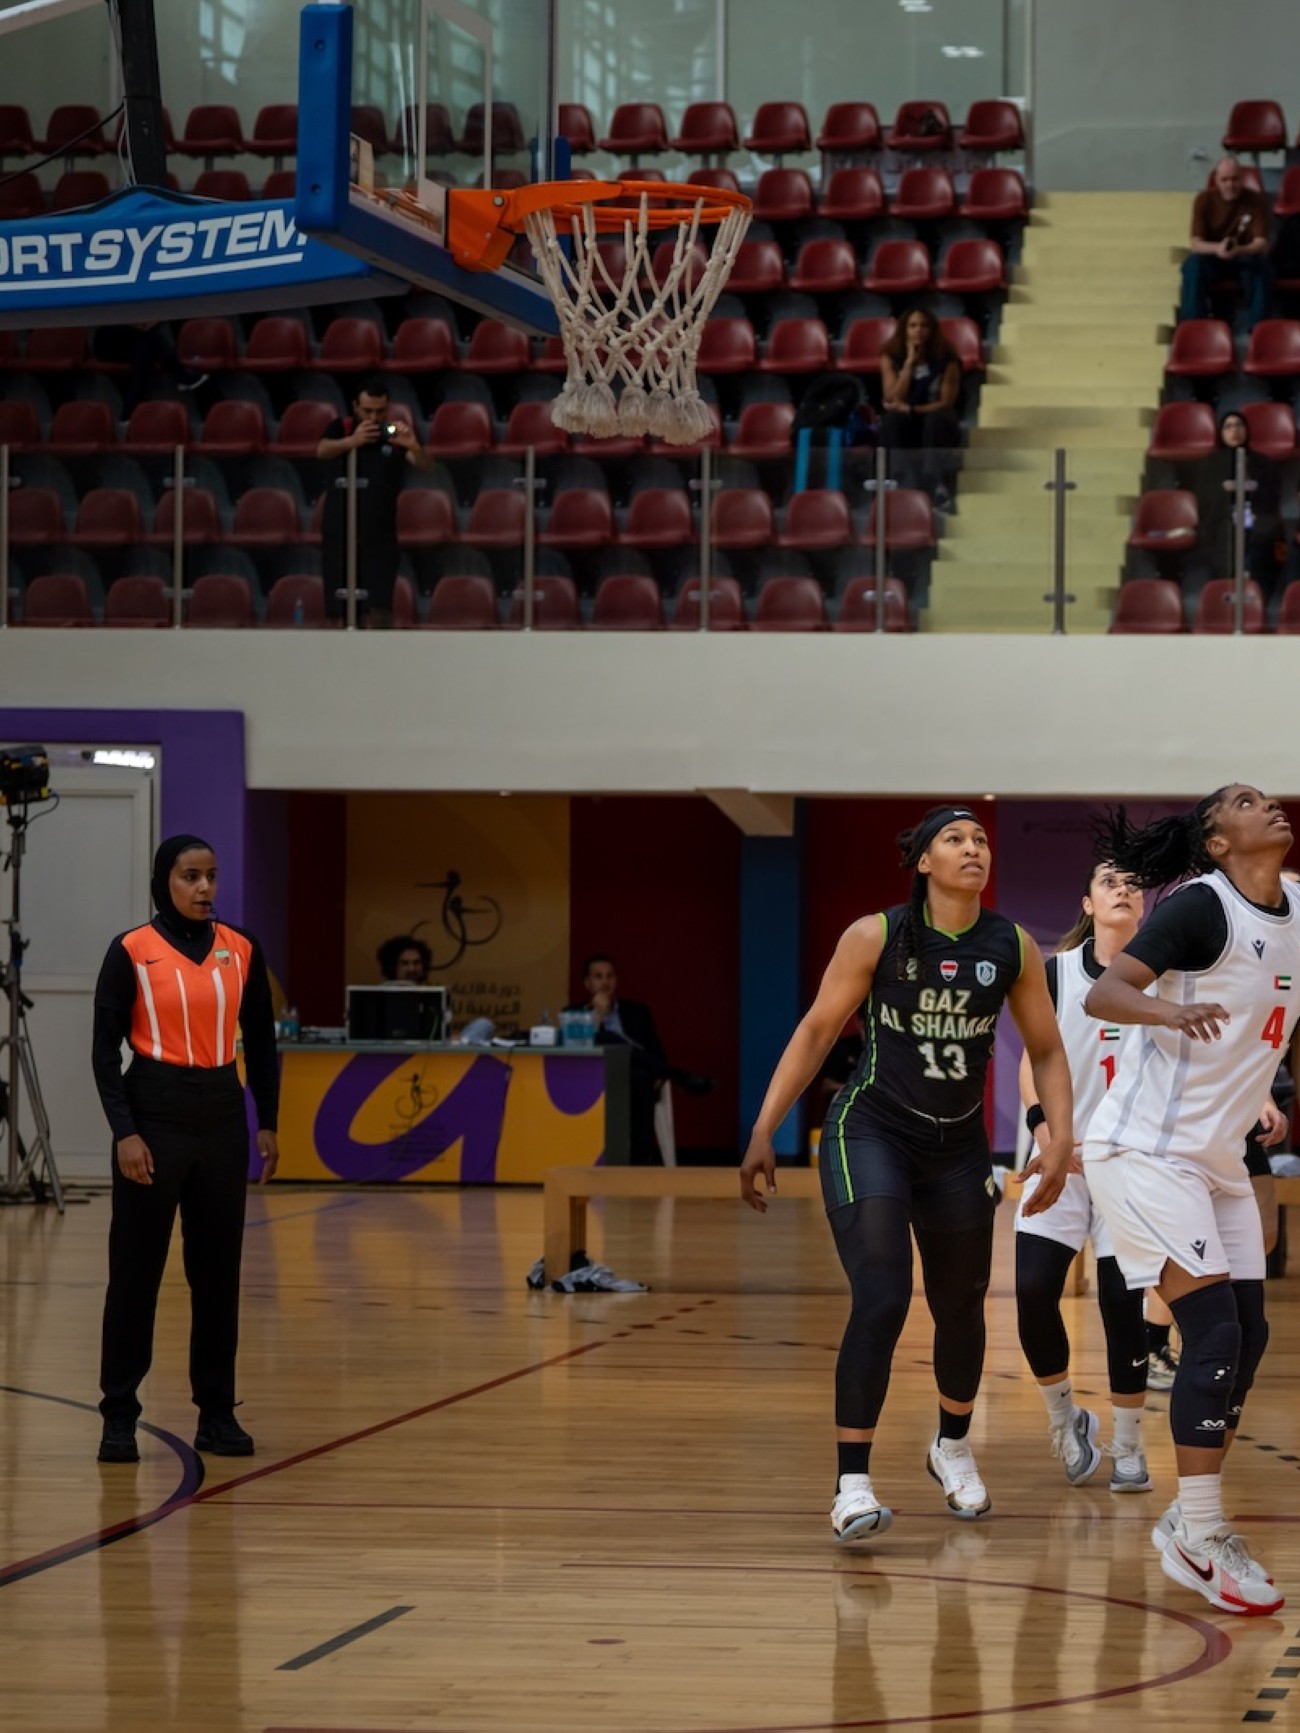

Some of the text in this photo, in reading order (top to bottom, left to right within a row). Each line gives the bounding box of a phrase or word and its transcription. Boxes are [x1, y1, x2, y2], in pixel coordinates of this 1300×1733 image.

[0, 208, 309, 283] RTSYSTEM
[880, 1002, 905, 1033] AL
[918, 987, 972, 1015] GAZ
[1260, 1006, 1287, 1050] 4
[918, 1041, 968, 1080] 13
